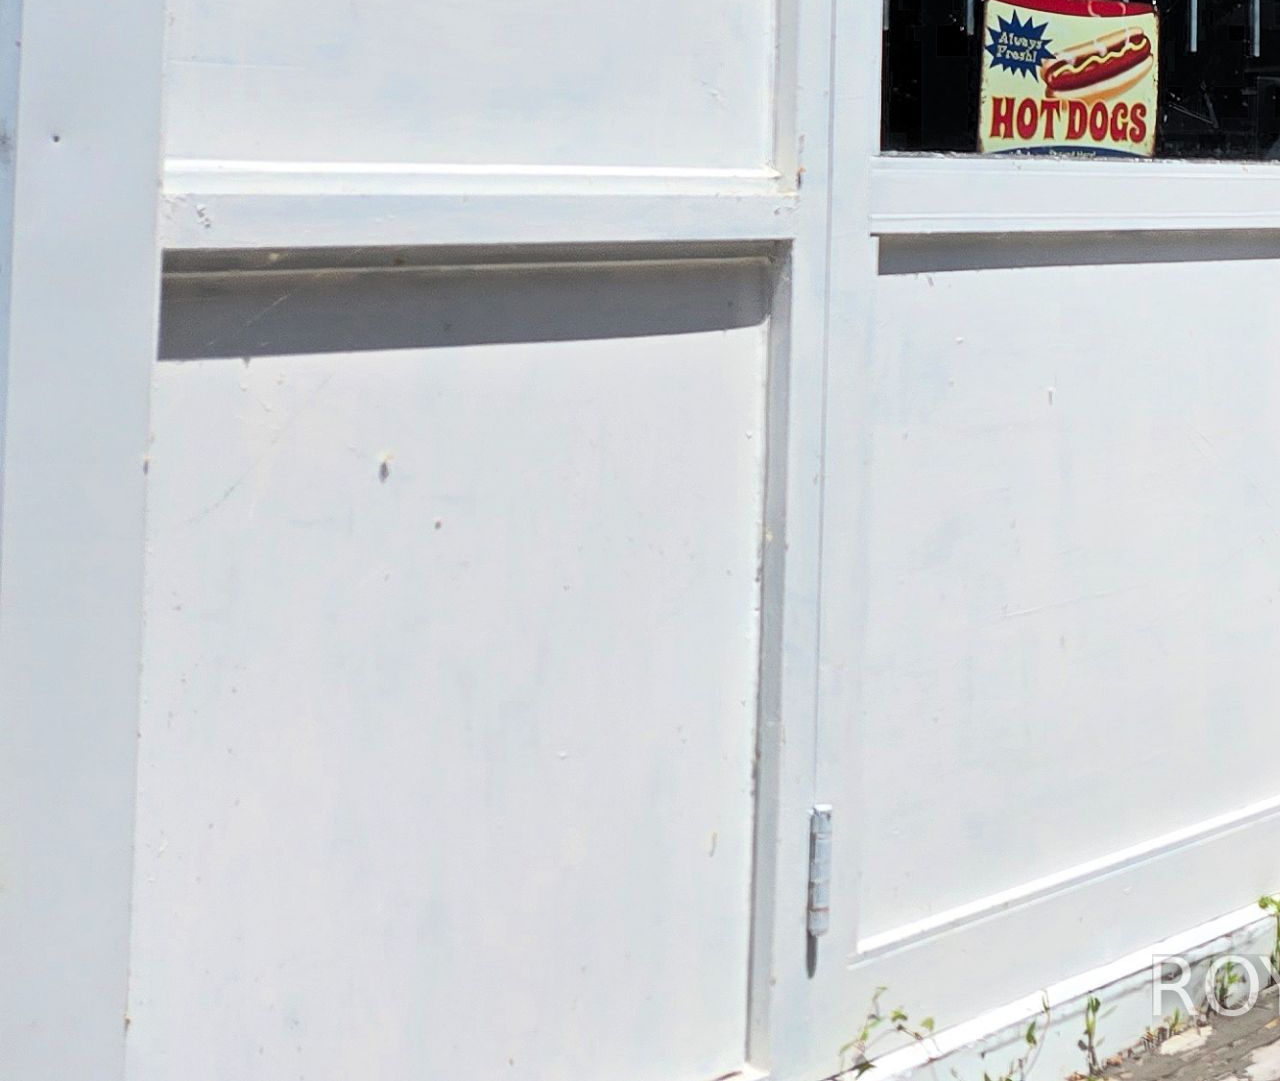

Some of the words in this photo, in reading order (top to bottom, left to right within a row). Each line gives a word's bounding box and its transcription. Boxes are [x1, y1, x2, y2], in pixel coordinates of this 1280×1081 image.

[1000, 32, 1042, 49] Always
[996, 45, 1037, 63] Fresh!
[990, 96, 1061, 140] HOT
[1065, 100, 1147, 143] DOGS
